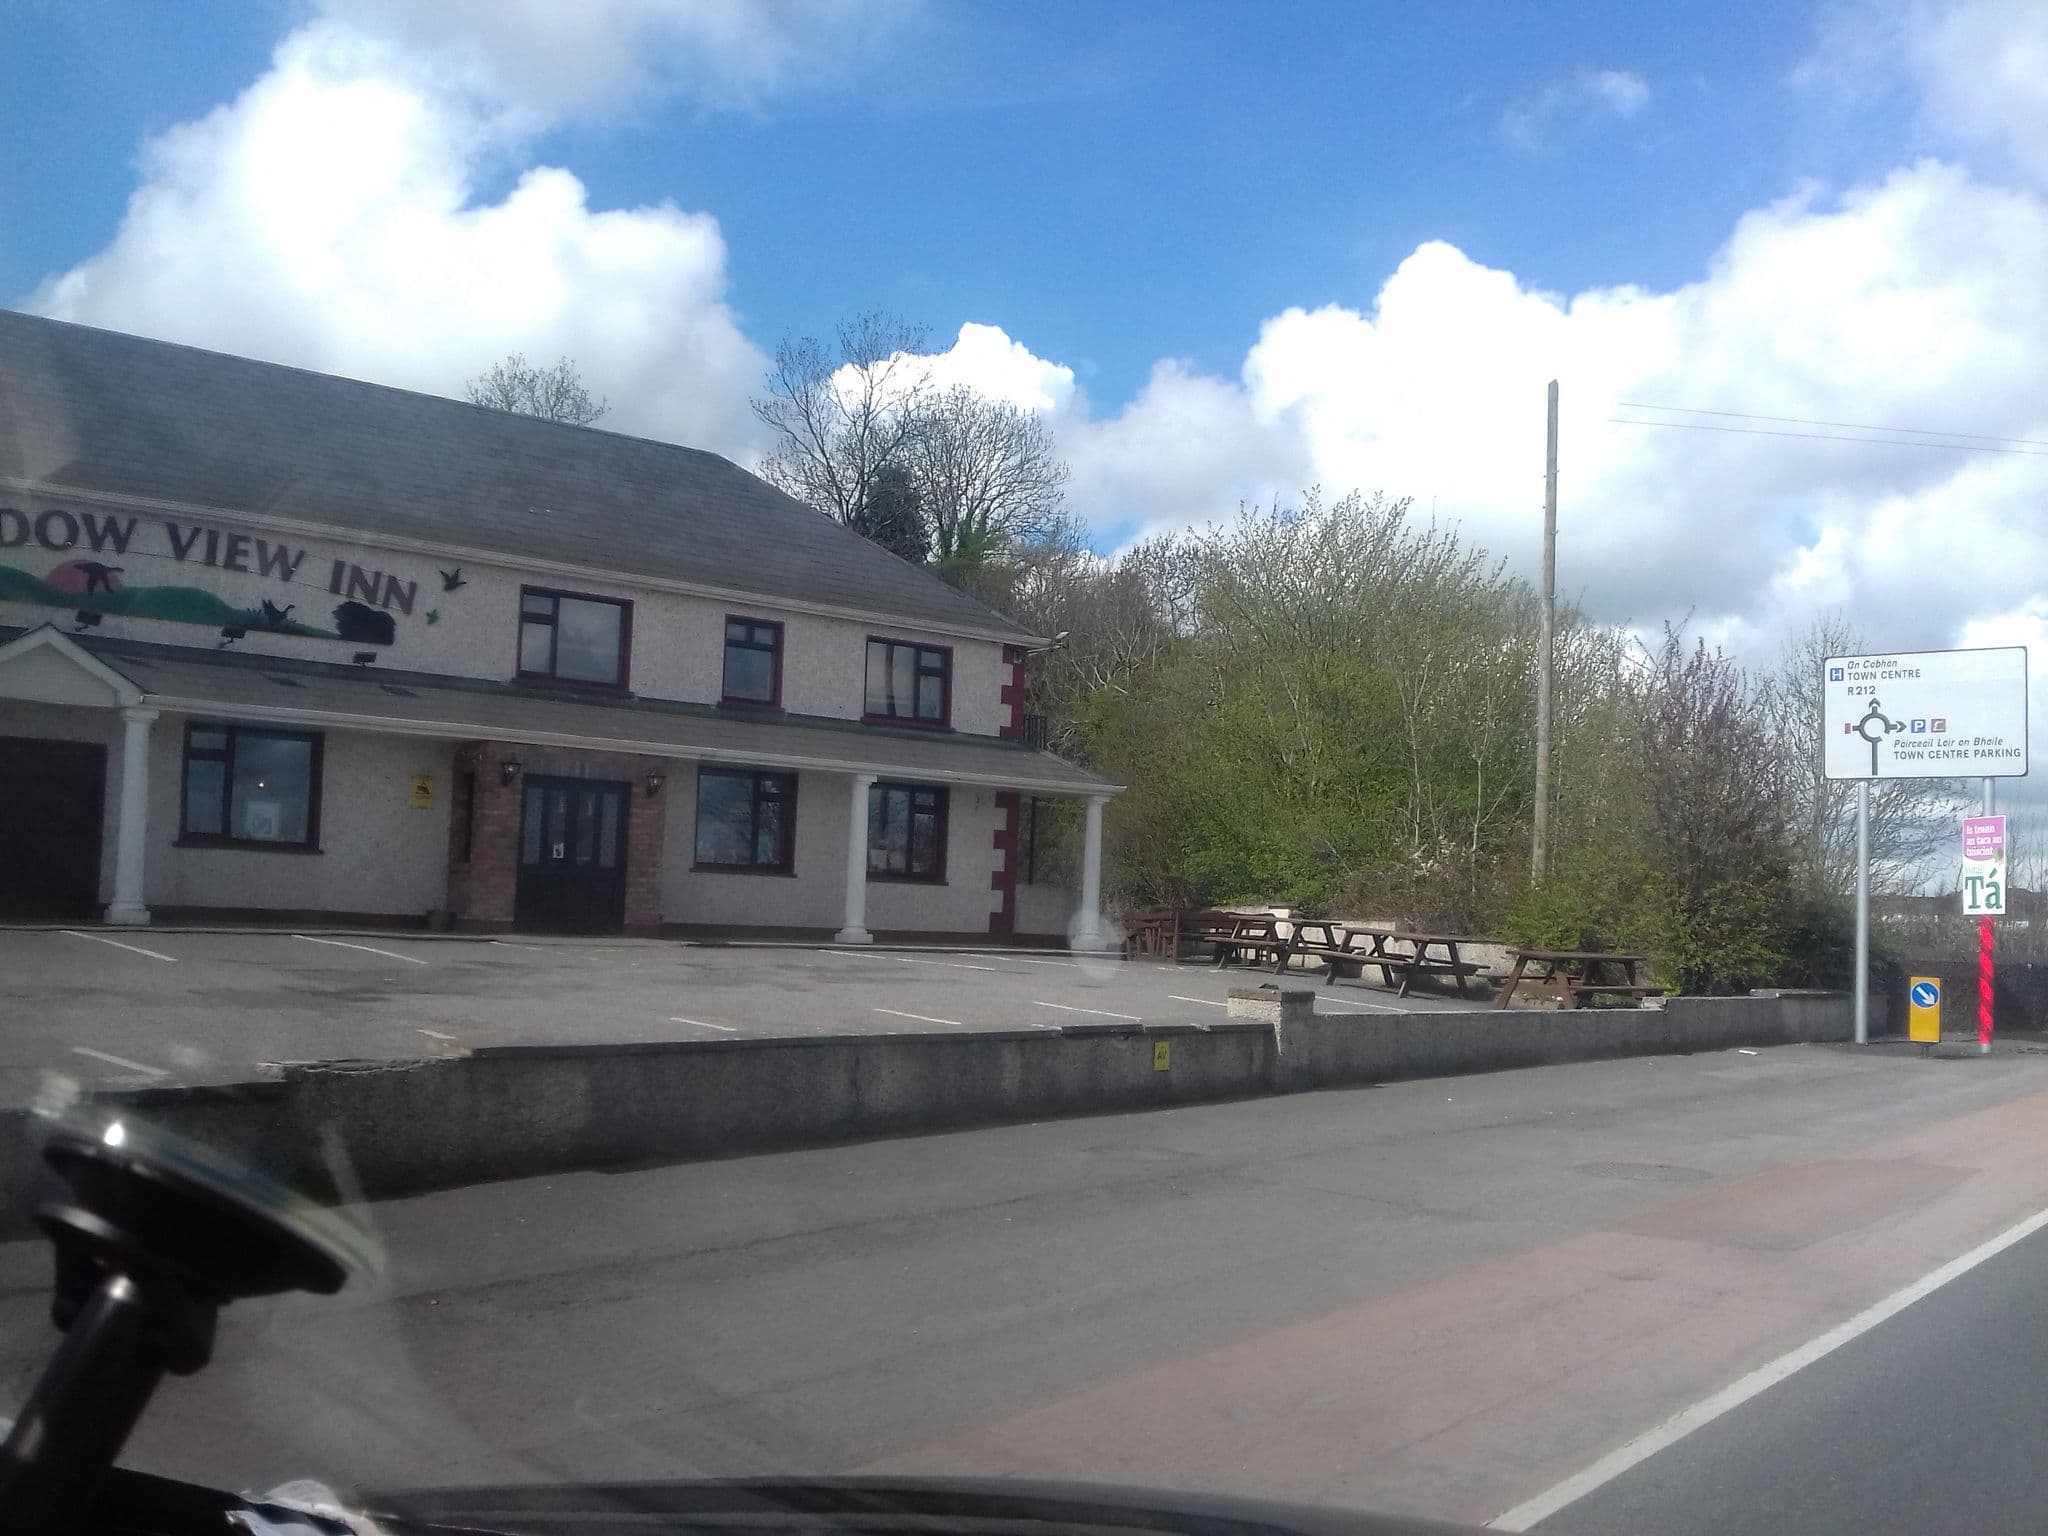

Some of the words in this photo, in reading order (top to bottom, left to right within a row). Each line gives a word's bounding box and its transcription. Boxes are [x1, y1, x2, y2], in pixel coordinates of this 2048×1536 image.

[165, 521, 307, 582] VIEW
[328, 558, 418, 615] INN
[1847, 671, 1877, 680] TOWN
[1880, 669, 1921, 679] CENTRE
[1847, 685, 1876, 695] R212
[1973, 737, 2004, 746] Bhaile
[1894, 751, 1924, 760] TOWN
[1928, 749, 1969, 759] CENTRE
[1974, 748, 2021, 758] PARKING
[1965, 867, 2003, 909] Tá
[1157, 1050, 1167, 1060] AV
